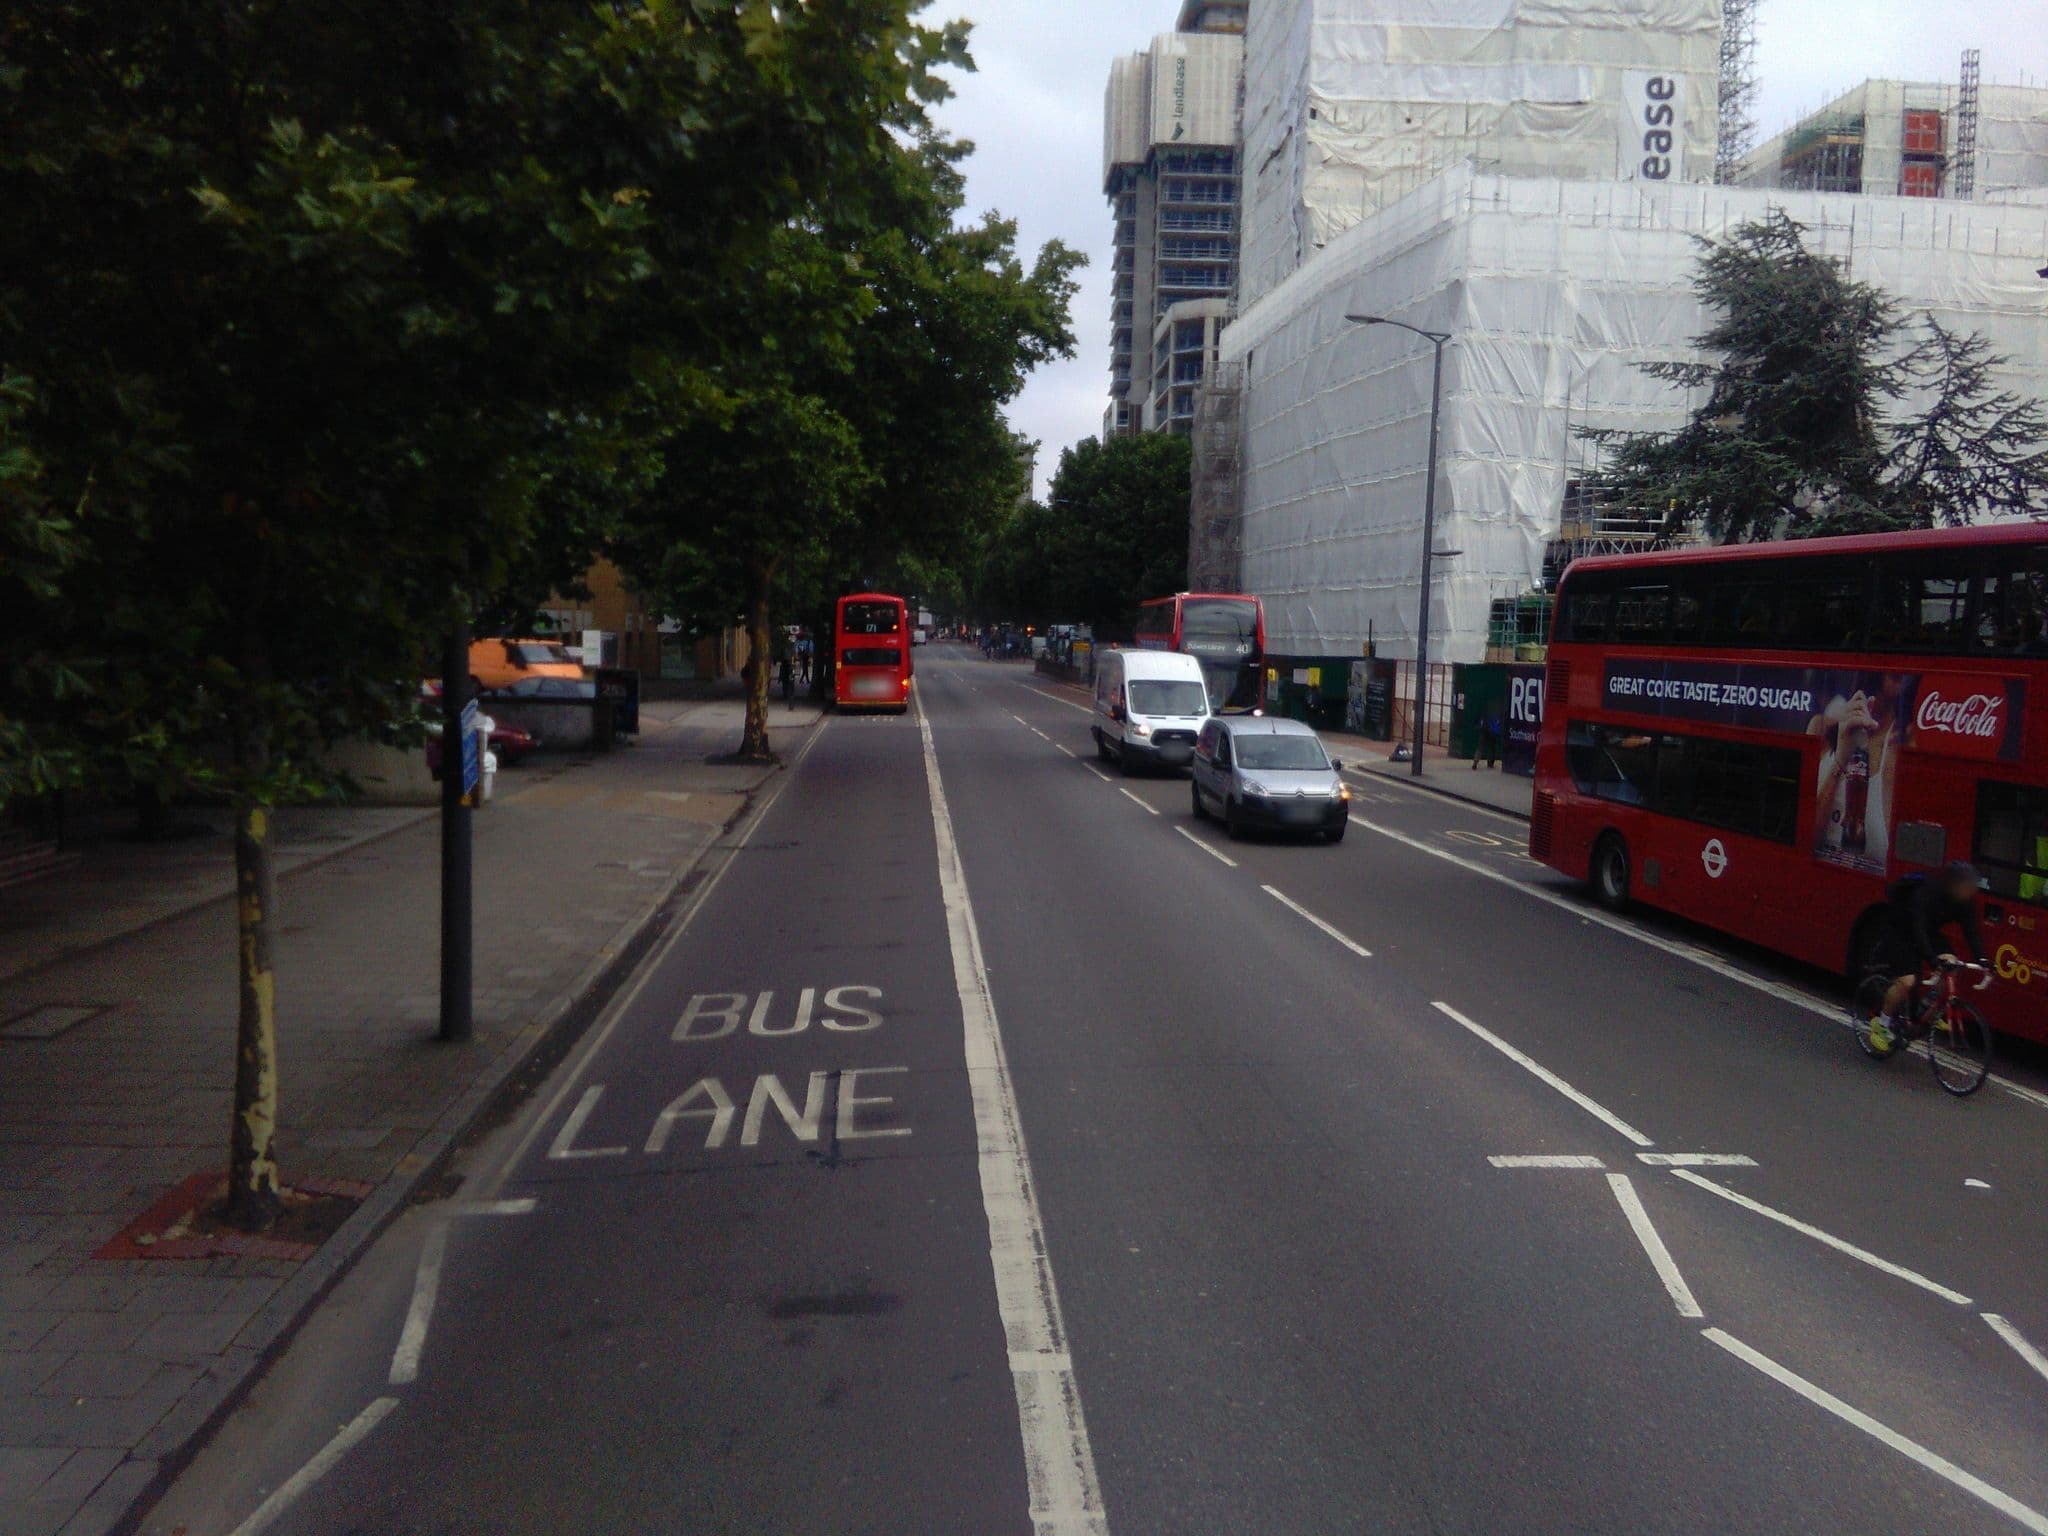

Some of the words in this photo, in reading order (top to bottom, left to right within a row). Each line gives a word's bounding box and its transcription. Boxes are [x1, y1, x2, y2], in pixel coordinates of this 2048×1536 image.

[1642, 77, 1675, 180] ease
[1235, 643, 1249, 655] 40
[1609, 676, 1645, 696] GREAT
[1646, 679, 1681, 698] COKE
[1720, 684, 1757, 706] ZERO
[1759, 687, 1811, 712] SUGAR
[1917, 691, 2003, 737] Coca-Cola
[671, 985, 884, 1041] BUS
[546, 1066, 912, 1159] LANE
